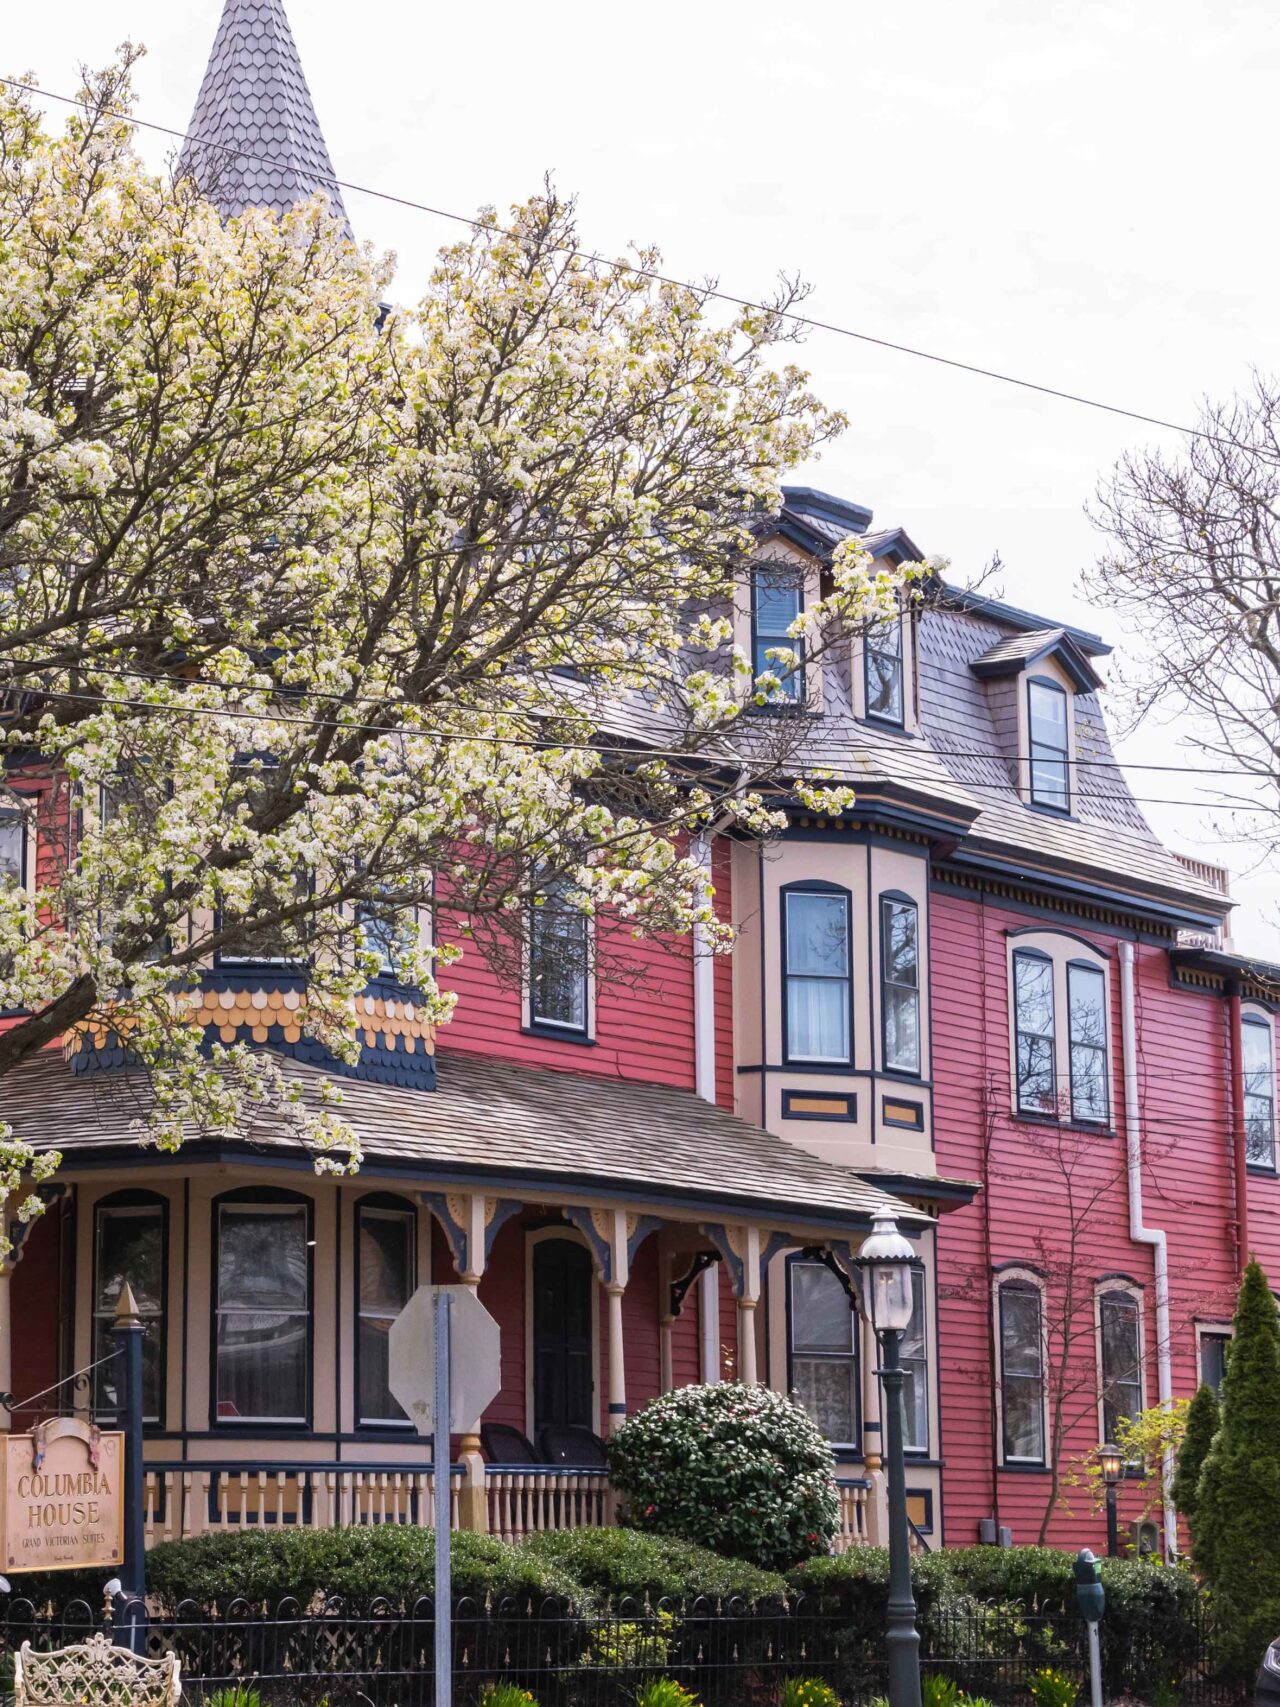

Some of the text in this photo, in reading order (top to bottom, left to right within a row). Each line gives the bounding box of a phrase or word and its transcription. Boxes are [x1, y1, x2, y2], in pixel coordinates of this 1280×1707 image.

[18, 1472, 112, 1498] COLUMBIA
[28, 1501, 100, 1528] HOUSE
[22, 1533, 105, 1548] GRAND VICTORIAN SUITES
